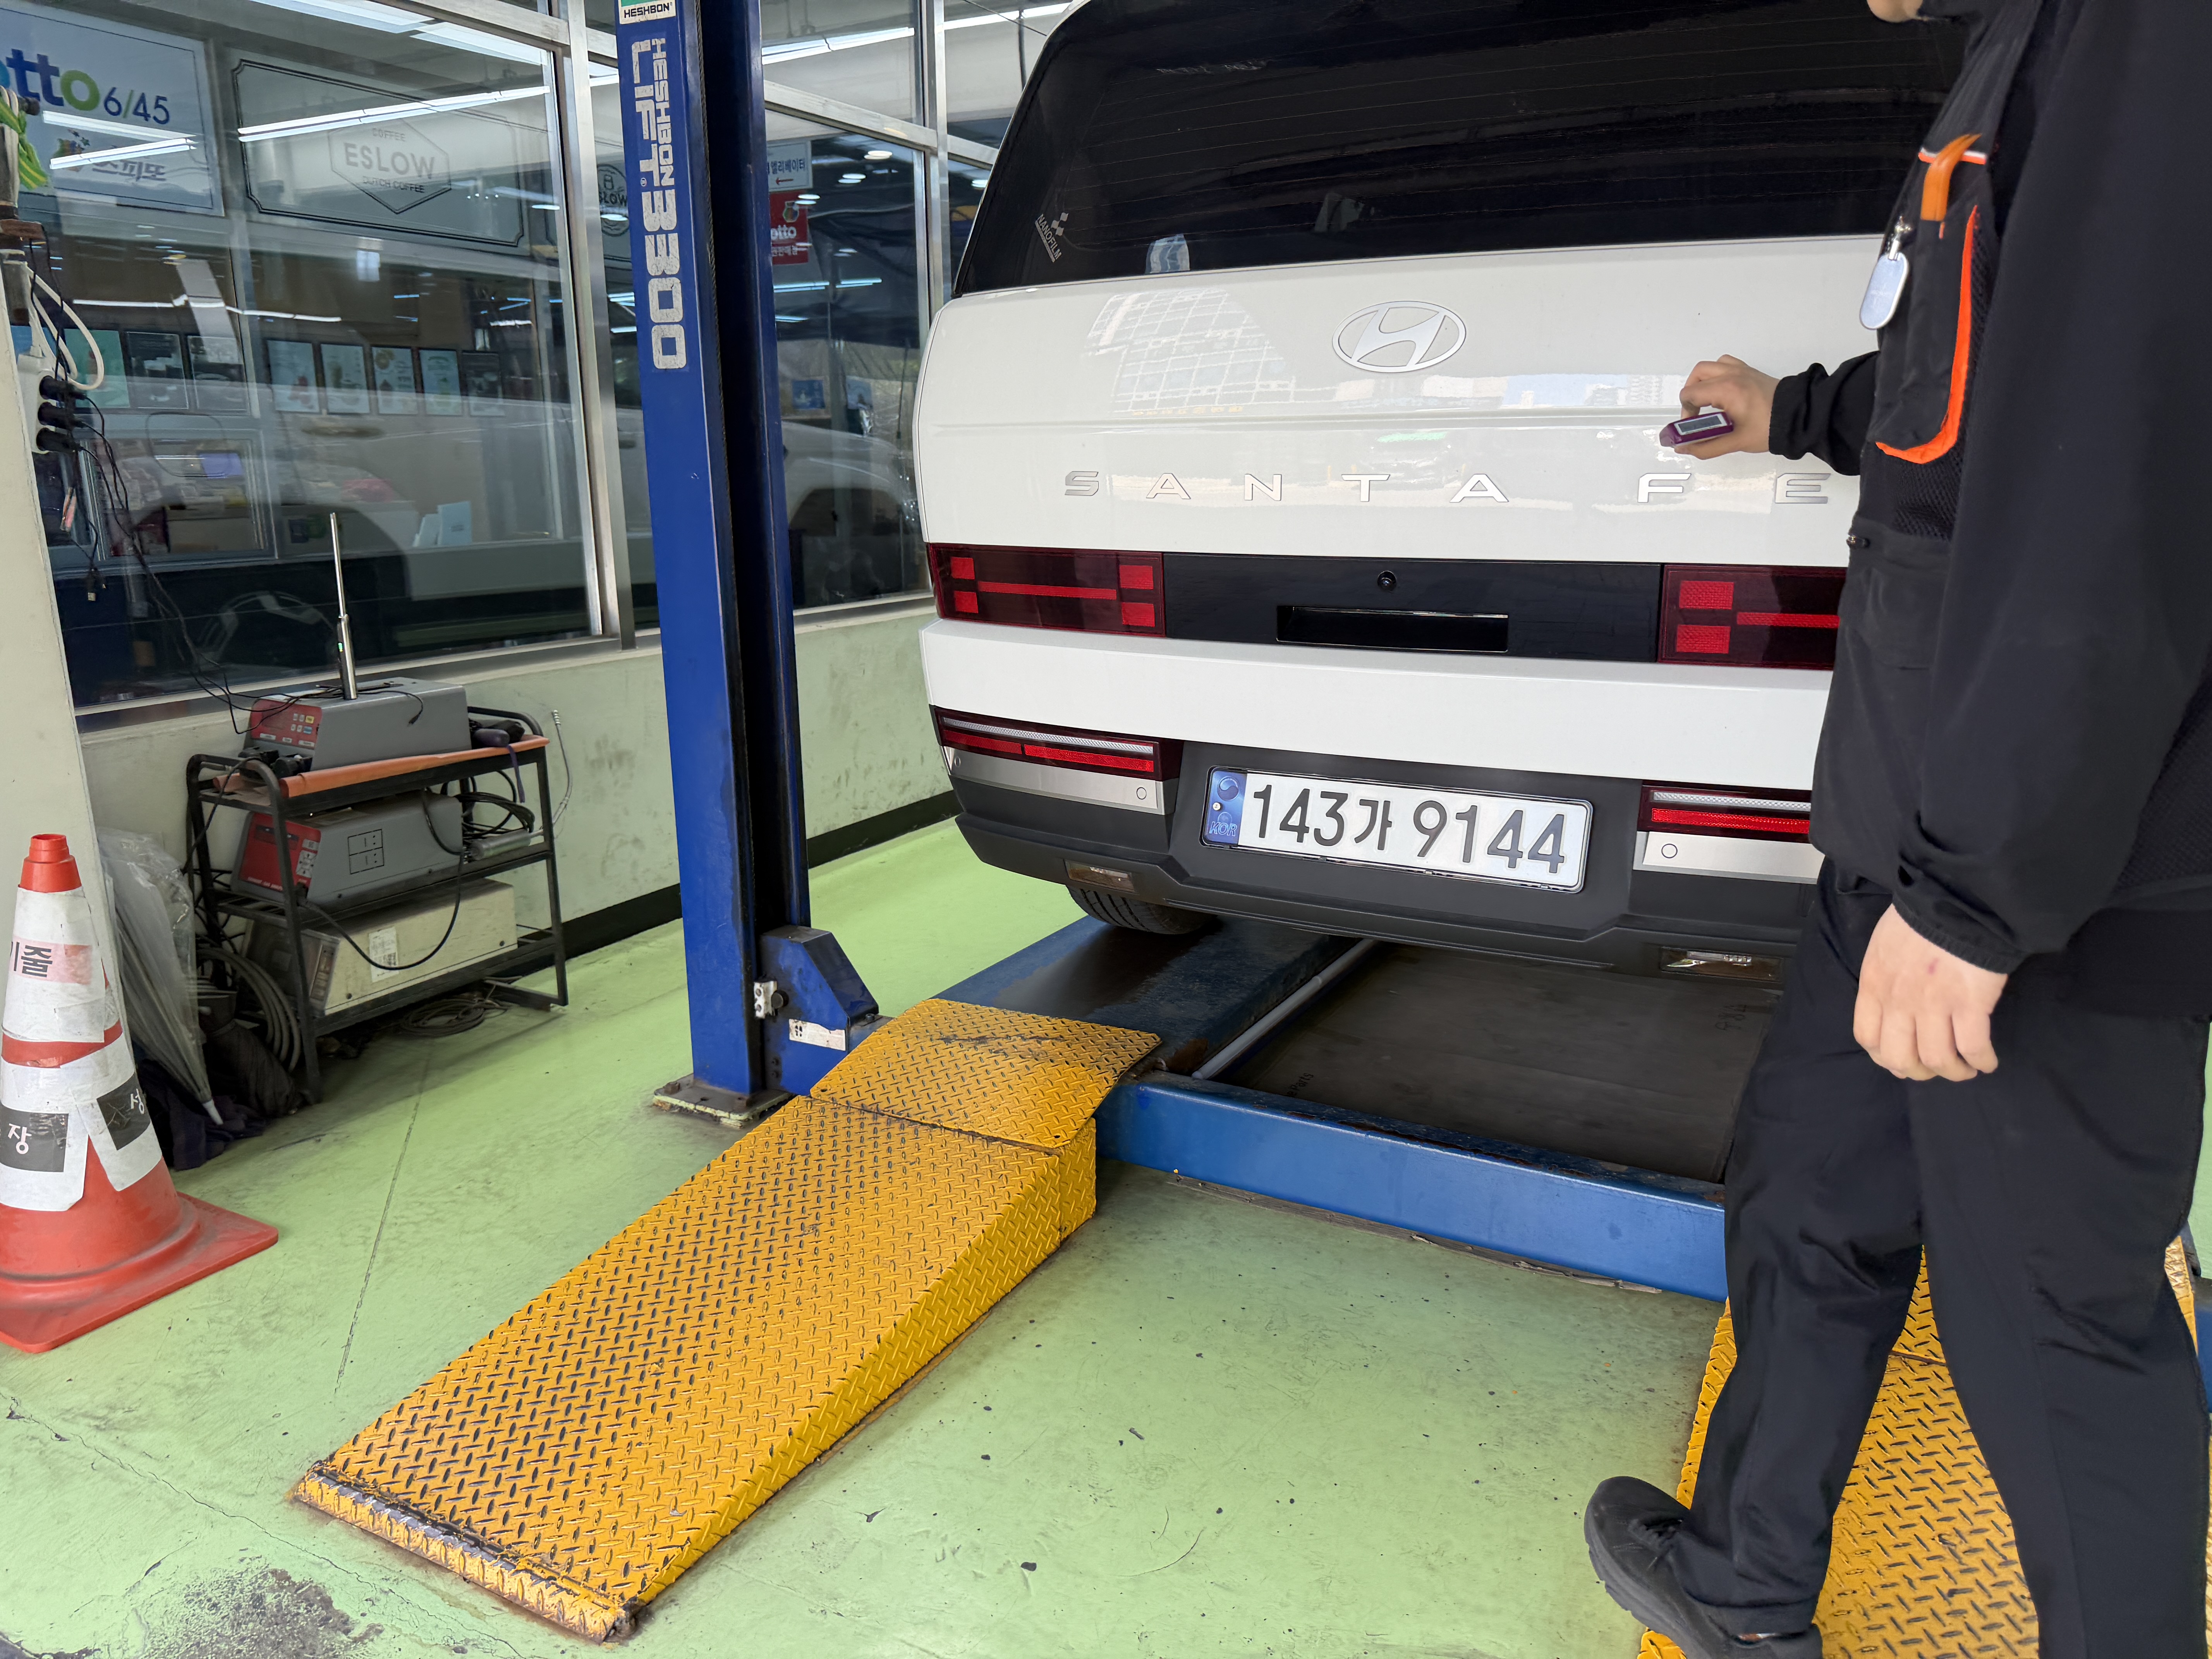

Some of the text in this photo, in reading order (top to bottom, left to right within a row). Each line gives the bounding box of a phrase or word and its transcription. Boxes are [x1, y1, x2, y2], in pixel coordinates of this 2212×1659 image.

[624, 2, 670, 19] HESHBON
[103, 87, 170, 125] 6/45
[651, 38, 675, 186] HESHBON
[343, 142, 435, 179] ESLOW
[631, 39, 687, 369] LIFT 3300
[1037, 213, 1062, 260] NANOFILM
[1064, 471, 1831, 504] SANTA FE
[1209, 821, 1237, 836] KOR
[1253, 784, 1565, 874] 143가 9144
[8, 1123, 32, 1154] 장
